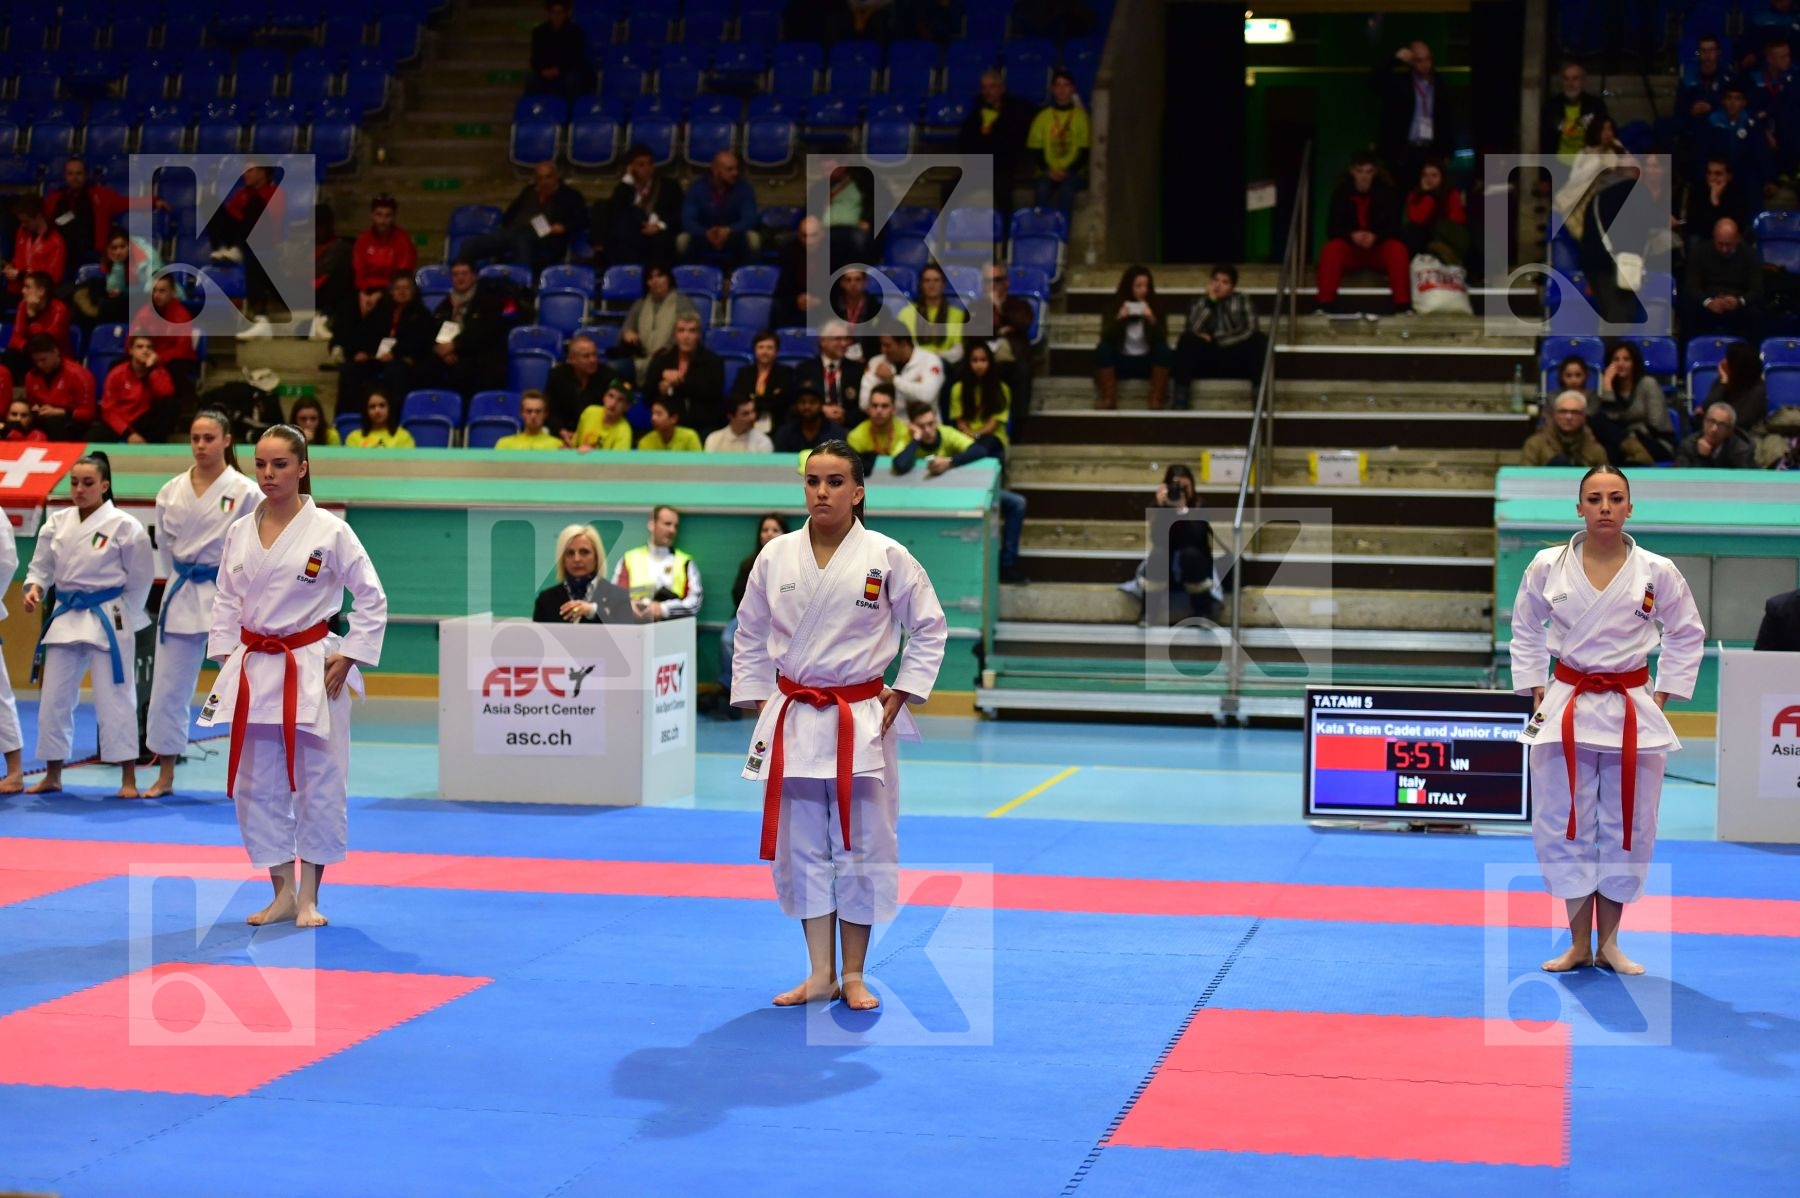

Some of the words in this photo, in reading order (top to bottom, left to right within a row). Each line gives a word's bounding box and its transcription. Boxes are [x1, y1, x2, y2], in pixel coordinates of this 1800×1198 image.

[1312, 694, 1362, 709] TATAMI
[1364, 696, 1373, 709] 5
[483, 703, 511, 715] Asia
[514, 703, 549, 717] Sport
[552, 704, 596, 716] Center
[506, 729, 572, 746] asc.ch
[1316, 722, 1345, 735] Kata
[1347, 722, 1381, 736] Team
[1384, 723, 1421, 737] Cadet
[1423, 725, 1448, 737] and
[1450, 725, 1491, 739] Junior
[1394, 741, 1445, 769] 5:57
[1398, 775, 1427, 791] Italy
[1428, 792, 1467, 806] ITALY
